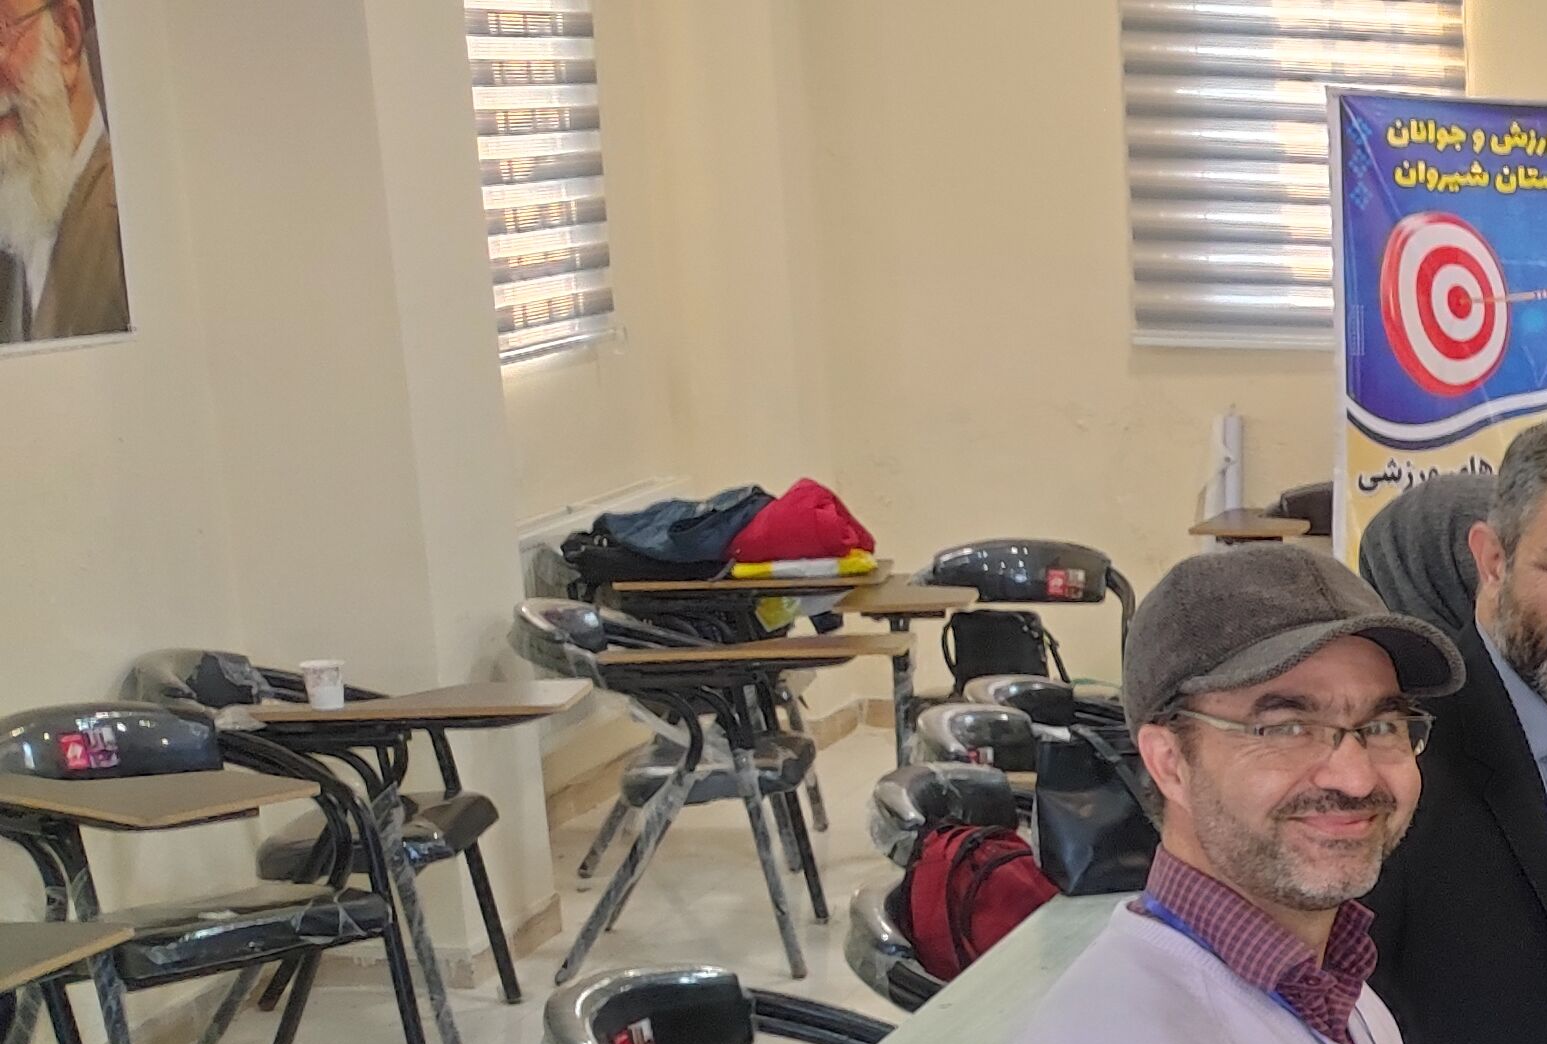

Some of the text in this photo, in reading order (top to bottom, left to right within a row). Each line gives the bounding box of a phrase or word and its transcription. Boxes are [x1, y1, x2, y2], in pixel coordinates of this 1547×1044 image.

[1386, 118, 1467, 152] جوانان
[1471, 126, 1486, 154] و
[1394, 160, 1490, 192] شیروان
